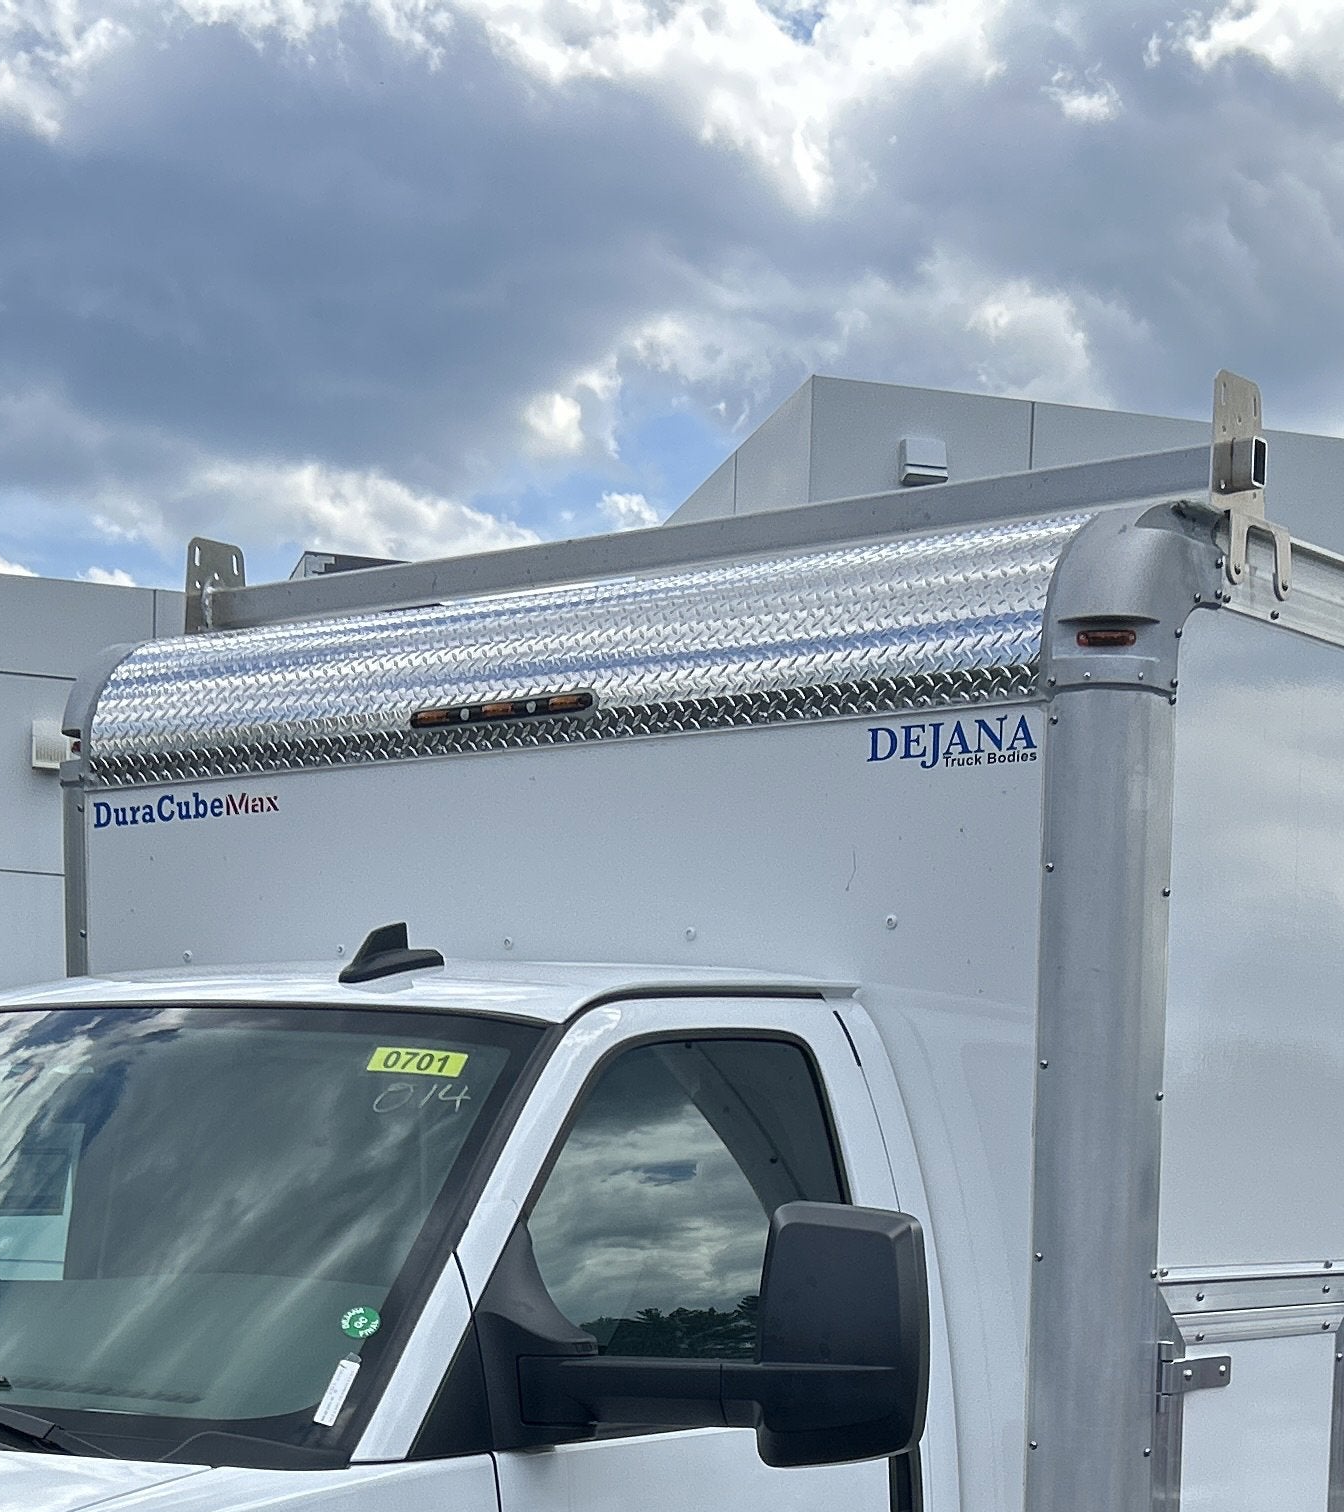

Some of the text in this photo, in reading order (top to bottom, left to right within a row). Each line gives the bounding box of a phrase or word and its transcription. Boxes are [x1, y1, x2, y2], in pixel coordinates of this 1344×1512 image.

[867, 715, 1038, 769] DEJANA
[943, 750, 1038, 768] Truck Bodies
[383, 1050, 451, 1073] 0701
